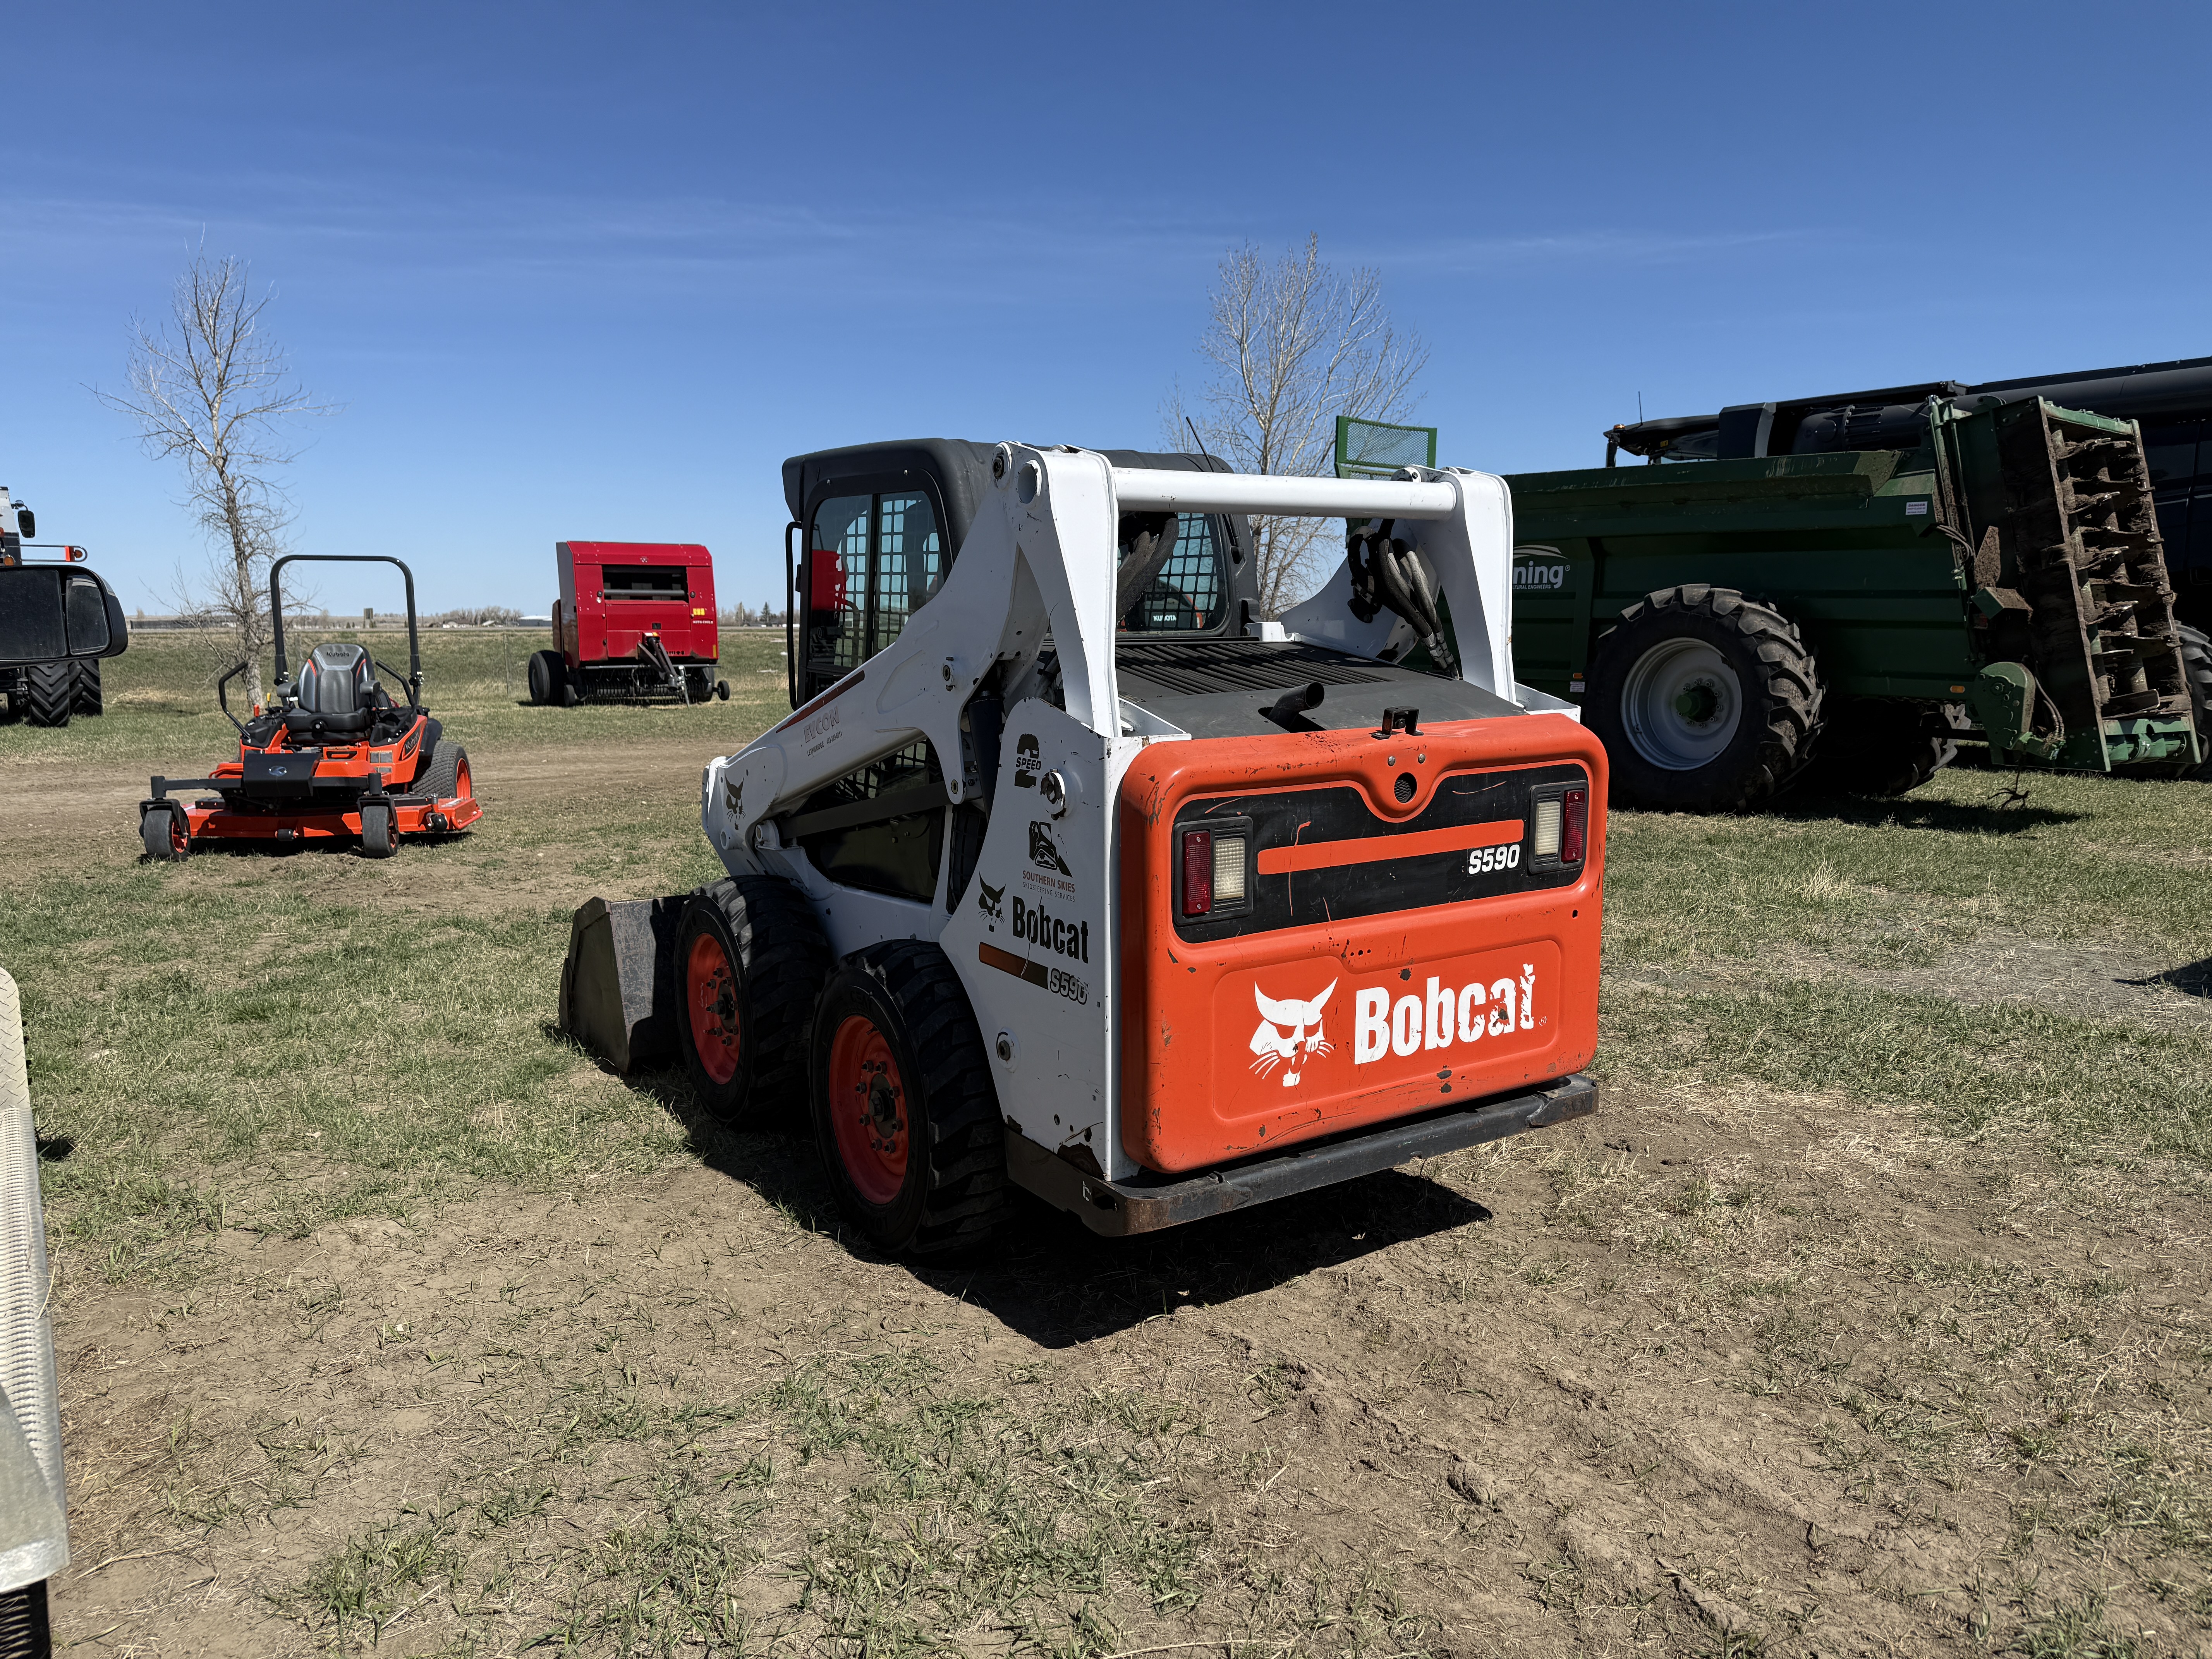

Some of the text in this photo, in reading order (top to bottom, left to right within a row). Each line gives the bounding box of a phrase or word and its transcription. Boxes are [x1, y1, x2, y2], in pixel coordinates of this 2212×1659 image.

[804, 706, 840, 743] EVCON
[1016, 757, 1041, 770] SPEED
[1468, 844, 1520, 874] S590
[1023, 870, 1075, 893] SOUTHERN SKIES
[1023, 882, 1075, 902] SKIDSTEERING SERVICES
[1013, 895, 1089, 964] Bobcat
[1050, 968, 1088, 1005] S590
[1354, 963, 1535, 1065] Bobcat
